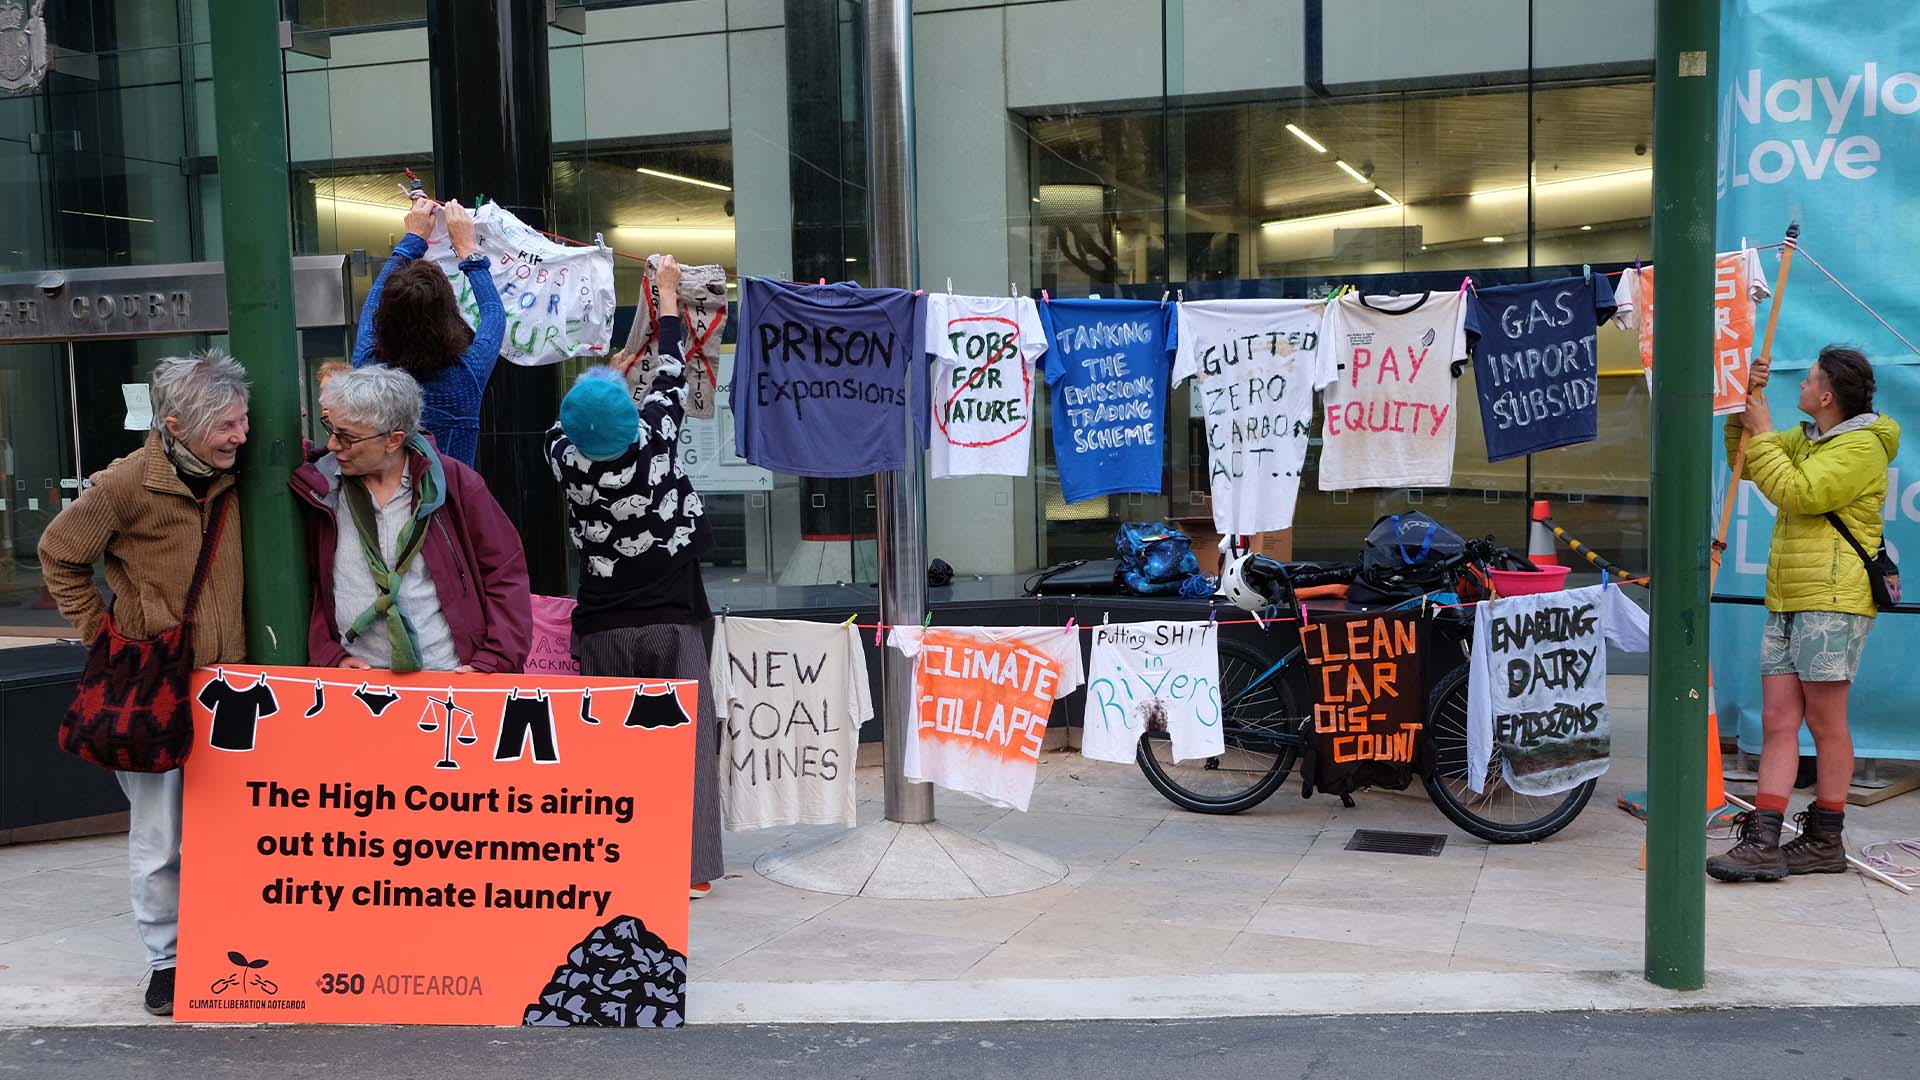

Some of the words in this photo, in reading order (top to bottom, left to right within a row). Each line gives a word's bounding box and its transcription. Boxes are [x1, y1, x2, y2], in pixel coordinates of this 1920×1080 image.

[1732, 135, 1881, 187] Love
[500, 252, 569, 288] JOBS
[518, 249, 543, 267] RIP
[70, 289, 192, 320] COURT
[501, 282, 561, 316] FOR
[1501, 291, 1575, 339] GAS
[694, 296, 708, 410] TRANSITION
[758, 320, 896, 369] PRISON
[1056, 321, 1153, 354] TANKING
[1203, 330, 1318, 376] GUTTED
[951, 366, 1003, 392] FOR
[1081, 352, 1131, 382] THE
[1352, 345, 1429, 389] PAY
[1488, 335, 1596, 387] IMPORT
[757, 371, 905, 420] Expansions
[1064, 375, 1154, 406] EMISSIONS
[1206, 373, 1287, 416] ZERO
[1492, 376, 1597, 430] SUBSIDY
[1067, 399, 1152, 428] TRADING
[1209, 414, 1311, 451] CARBON
[1327, 400, 1450, 437] EQUITY
[1073, 422, 1156, 453] SCHEME
[1155, 624, 1214, 647] SHIT
[1299, 617, 1416, 665] CLEAN
[1491, 603, 1599, 653] ENABLING
[728, 651, 827, 689] NEW
[1145, 650, 1163, 669] in
[1507, 645, 1597, 698] DAIRY
[1090, 666, 1219, 732] Rivers
[1322, 662, 1399, 704] CAR
[727, 696, 840, 740] COAL
[918, 695, 1048, 759] COLLAPS
[1496, 702, 1604, 747] EMISSIONS
[1333, 723, 1423, 763] COUNT
[728, 746, 839, 786] MINES
[246, 781, 310, 808] The
[319, 782, 396, 818] High
[404, 785, 500, 814] Court
[507, 786, 533, 814] is
[540, 787, 634, 824] airing
[257, 831, 314, 857] out
[321, 830, 385, 858] this
[392, 837, 620, 867] government's
[262, 877, 345, 912] dirty
[352, 879, 476, 908] climate
[484, 882, 612, 917] laundry
[188, 999, 223, 1010] CLIMATE
[223, 999, 266, 1010] LIBERATION
[266, 999, 306, 1010] AOTEAROA
[371, 974, 483, 996] AOTEAROA
